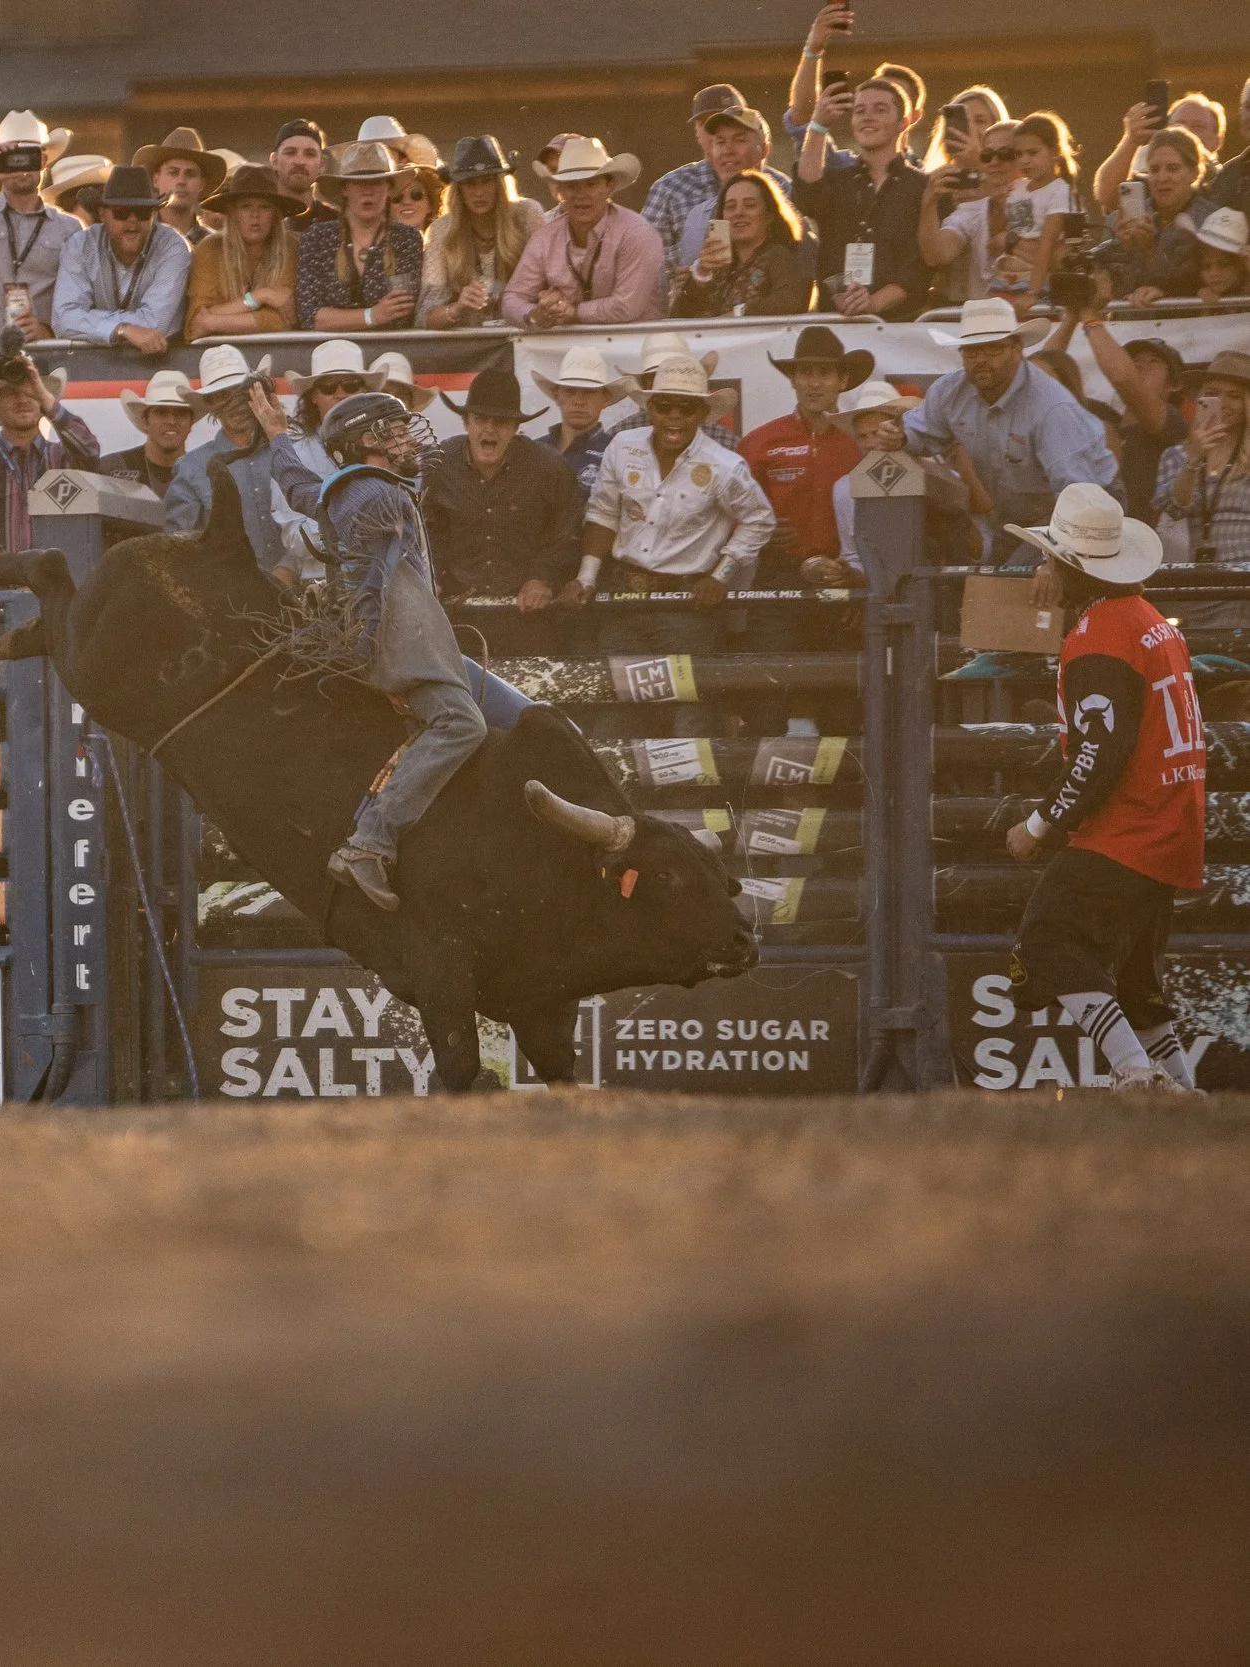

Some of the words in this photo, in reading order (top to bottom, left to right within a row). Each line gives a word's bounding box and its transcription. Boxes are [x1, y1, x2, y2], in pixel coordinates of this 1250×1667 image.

[613, 592, 647, 600] LMNT
[738, 590, 776, 598] DRINK
[779, 590, 802, 598] MIX
[1050, 781, 1081, 819] SKY
[1071, 741, 1100, 783] PBR
[68, 703, 96, 990] riefert
[219, 987, 393, 1037] STAY
[615, 1018, 705, 1040] ZERO
[715, 1018, 830, 1041] SUGAR
[219, 1047, 437, 1097] SALTY
[615, 1050, 810, 1071] HYDRATION
